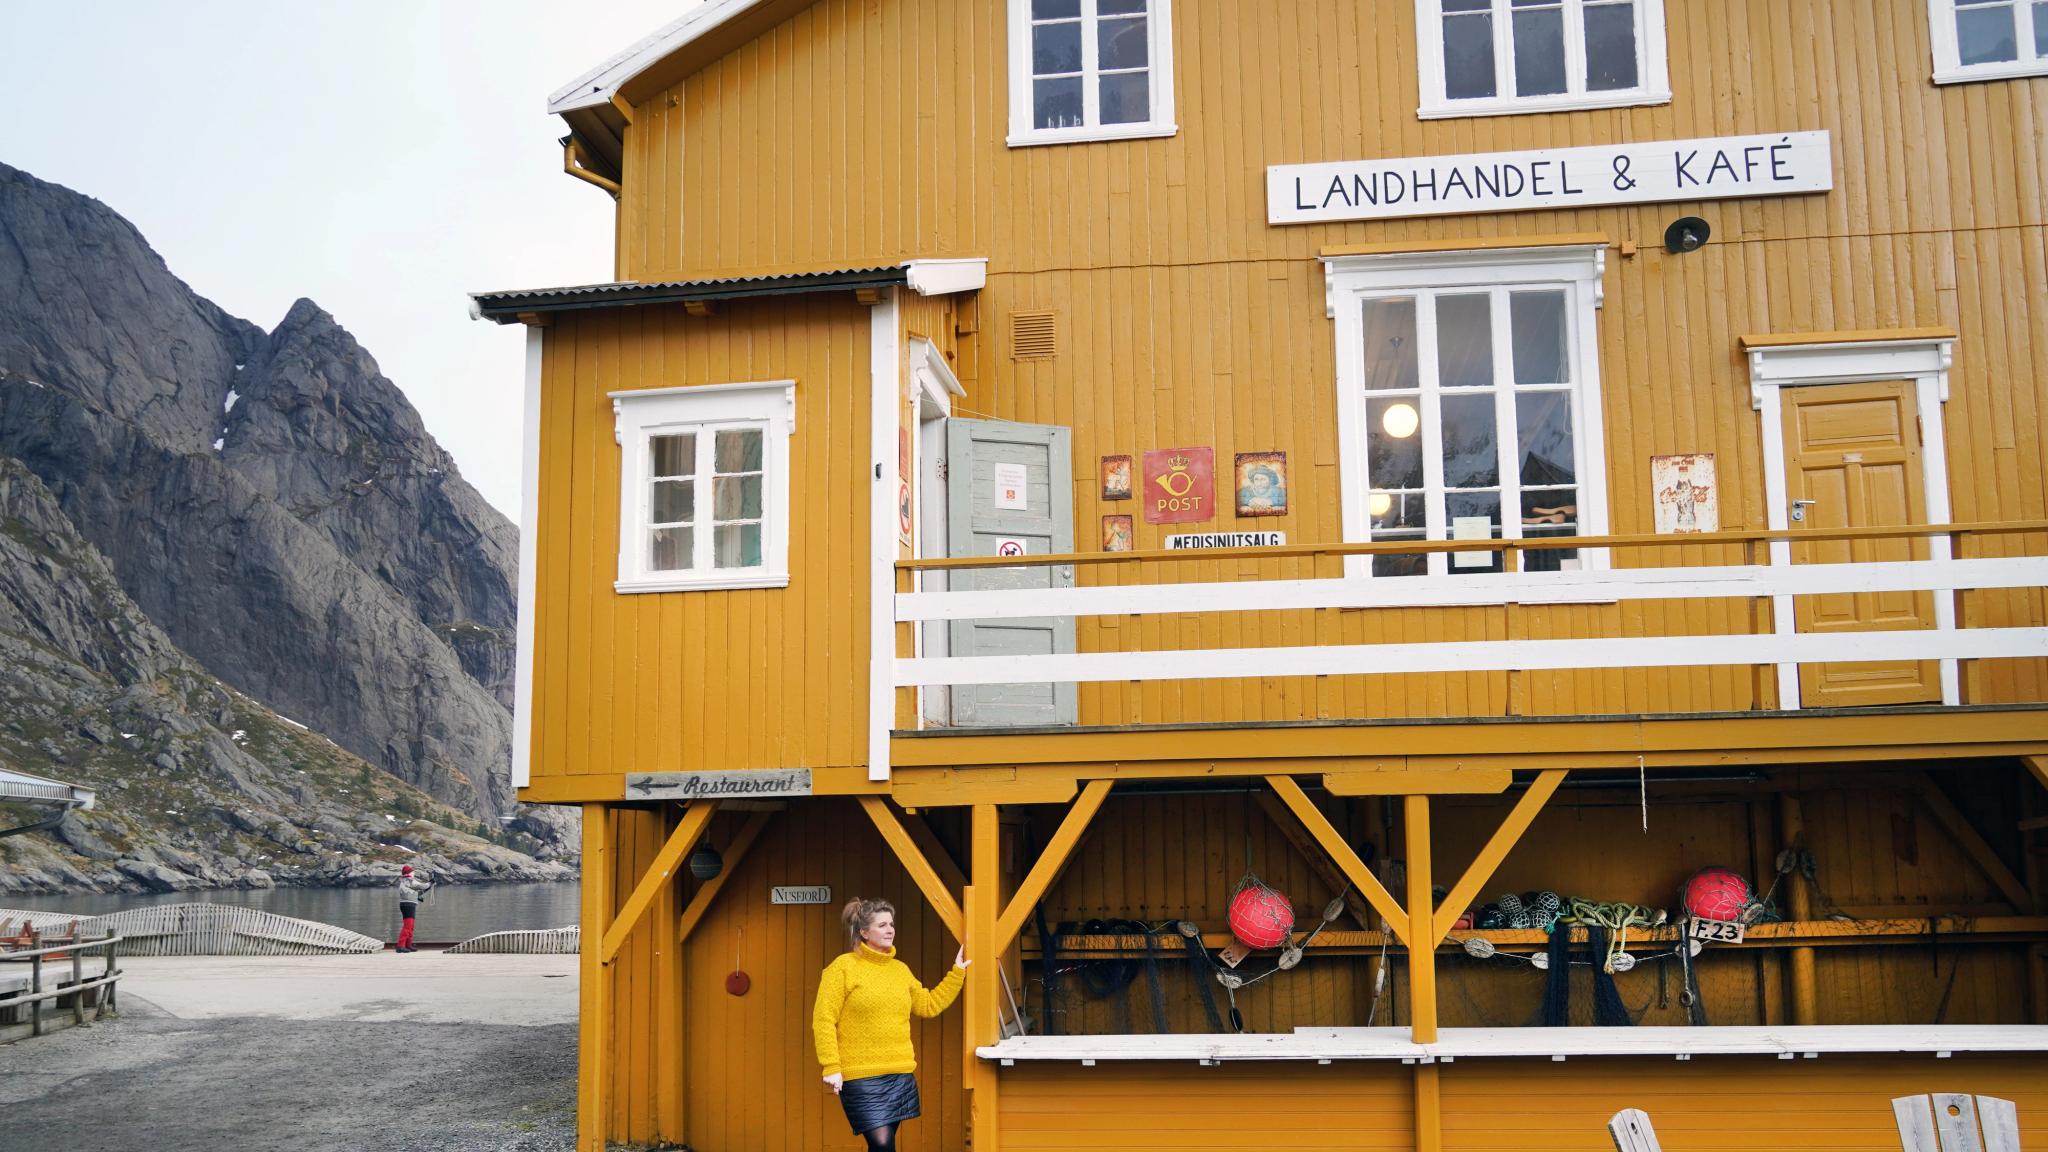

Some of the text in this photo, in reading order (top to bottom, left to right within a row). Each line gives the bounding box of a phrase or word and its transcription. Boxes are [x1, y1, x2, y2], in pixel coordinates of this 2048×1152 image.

[1296, 136, 1795, 211] LANDHANDEL & KAFÉ
[1157, 496, 1202, 512] POST
[684, 774, 796, 795] Restaurant
